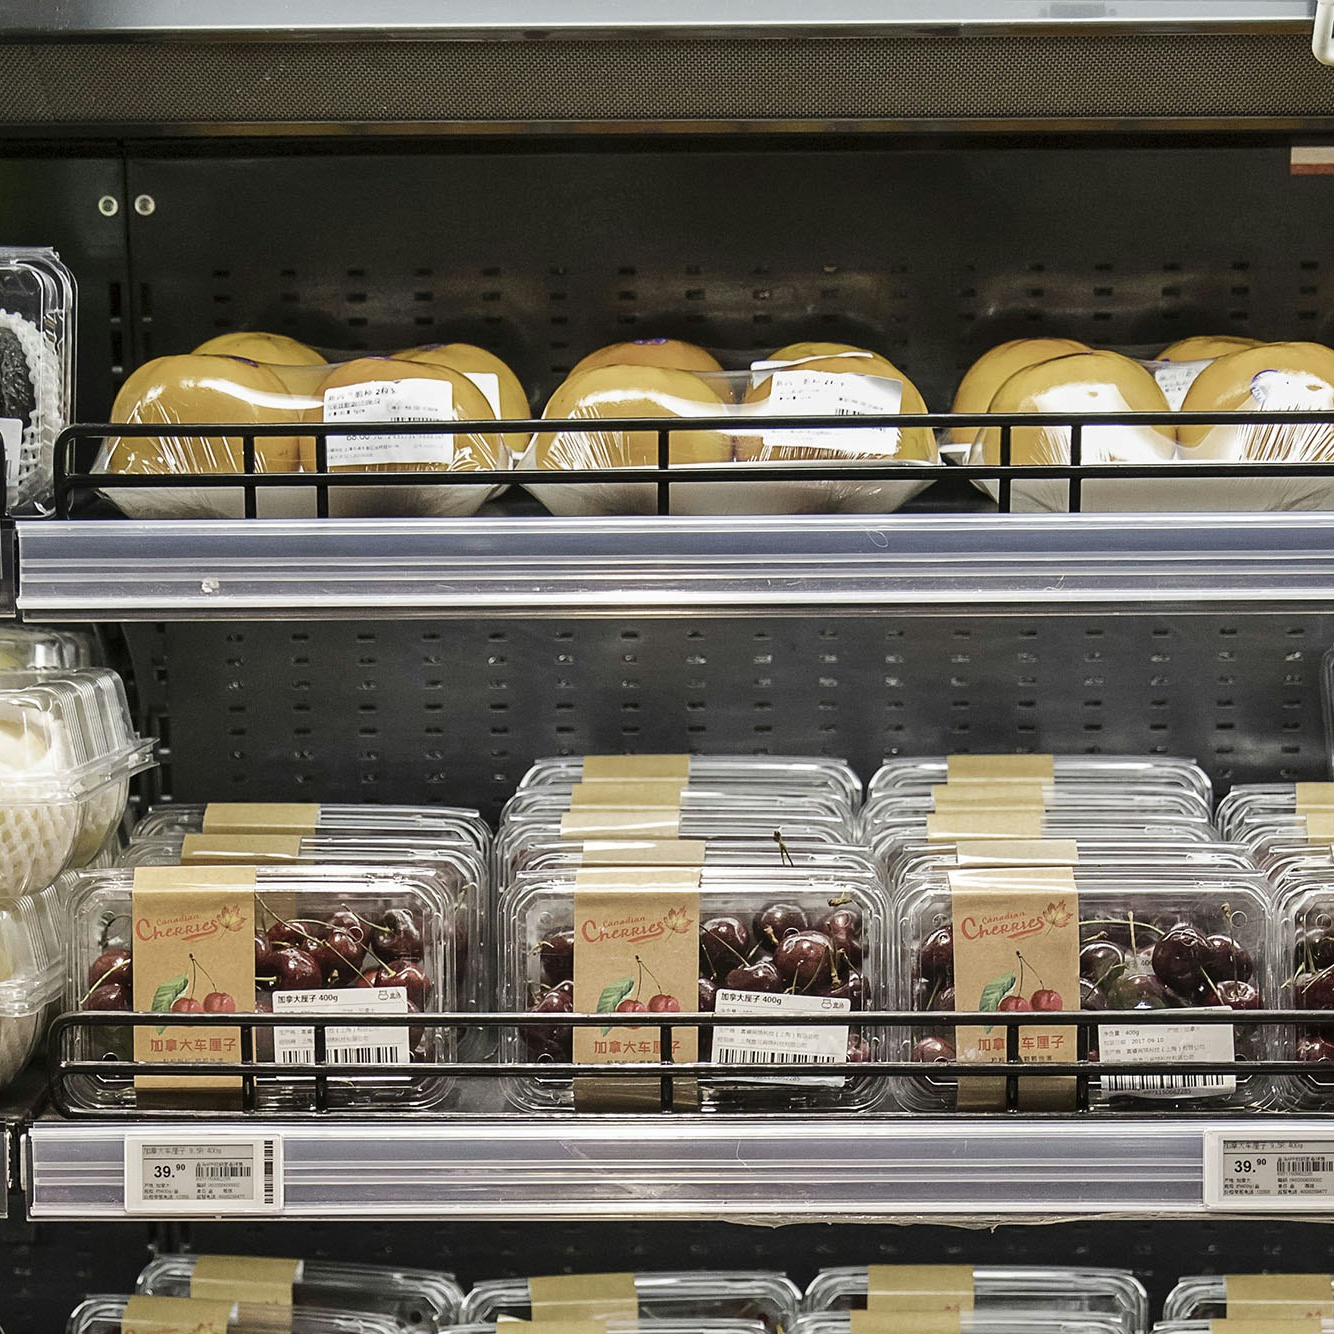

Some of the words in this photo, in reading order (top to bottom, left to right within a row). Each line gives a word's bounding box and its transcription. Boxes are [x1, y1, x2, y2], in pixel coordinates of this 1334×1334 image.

[156, 913, 199, 926] Canadian
[603, 916, 645, 928] Canadian
[982, 911, 1027, 925] Canadian
[136, 918, 218, 942] Cherries
[582, 918, 664, 943] Cherries
[961, 916, 1044, 941] Cherries
[319, 994, 338, 1002] 400g
[763, 997, 782, 1005] 400g
[150, 1038, 236, 1052] 加拿大车厘子
[978, 1035, 1065, 1051] 加拿车厘子
[154, 1164, 185, 1178] 39.90
[1234, 1158, 1267, 1173] 39.90
